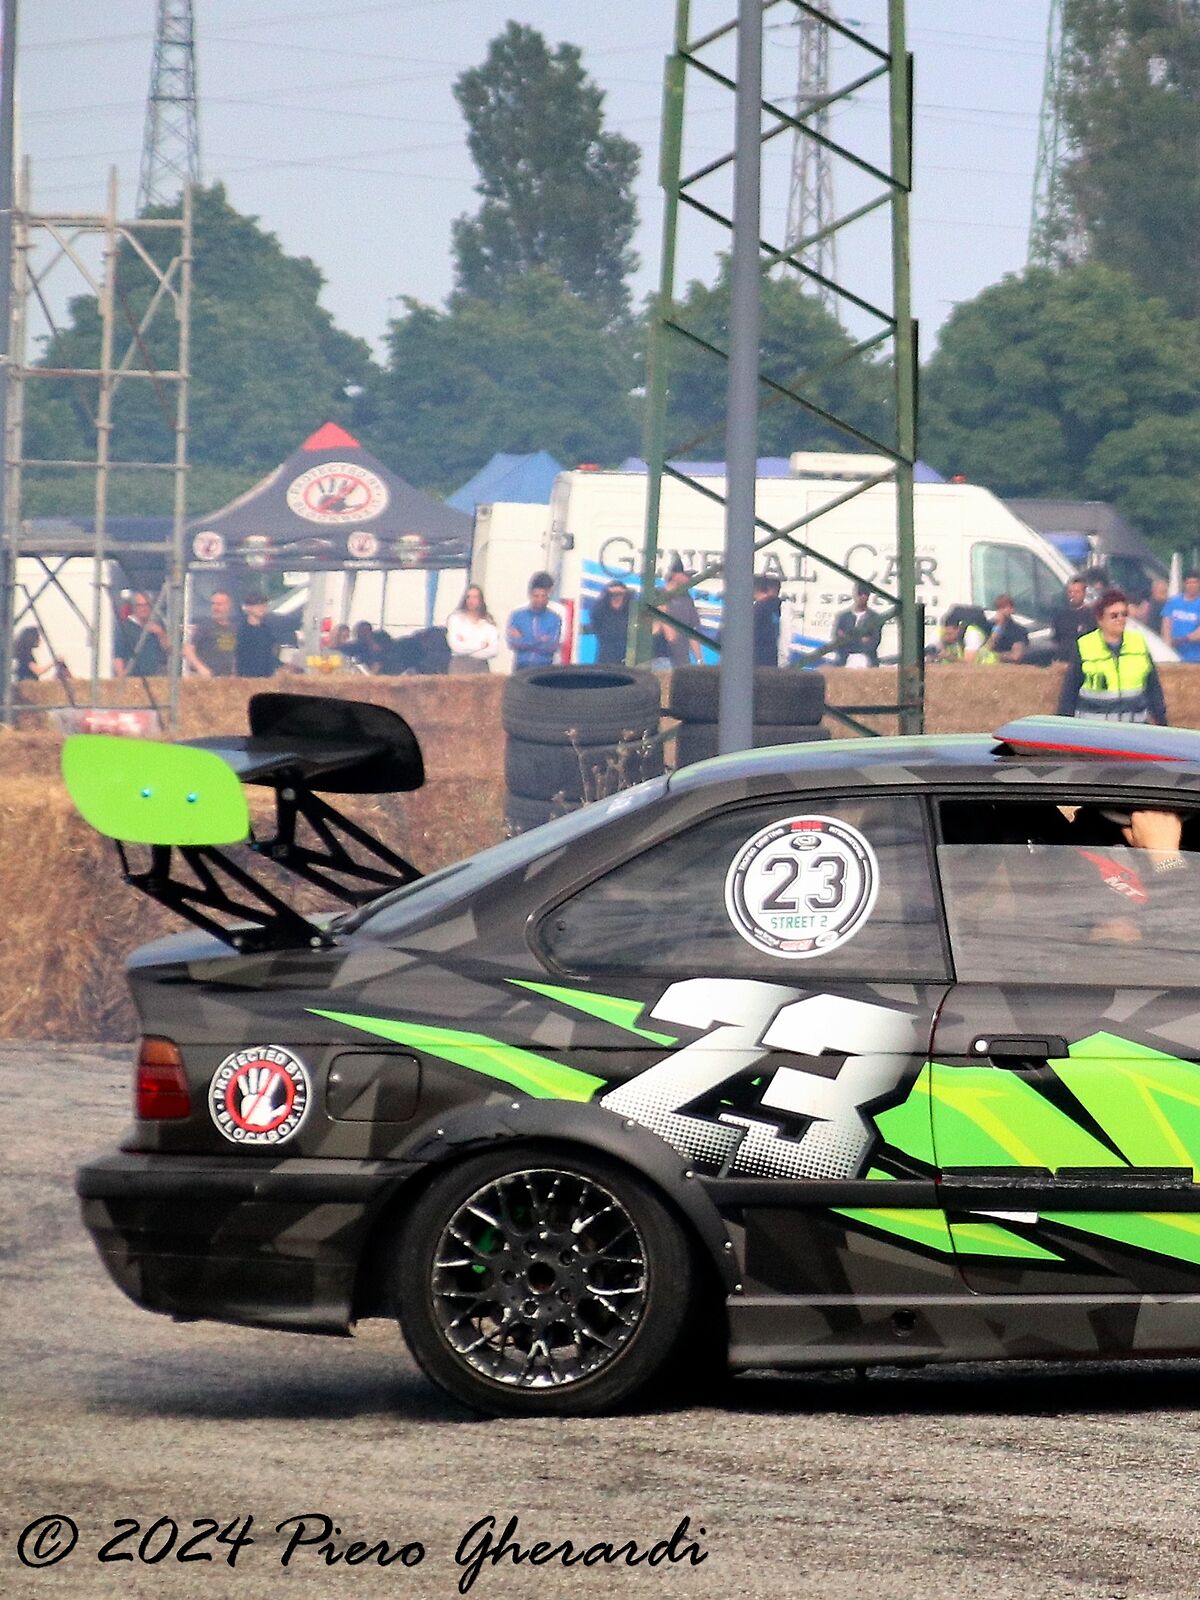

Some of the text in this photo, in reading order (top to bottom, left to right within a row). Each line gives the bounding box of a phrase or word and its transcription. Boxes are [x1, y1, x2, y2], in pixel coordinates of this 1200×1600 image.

[759, 854, 849, 912] 23
[770, 916, 828, 929] STREET 2
[213, 1049, 304, 1100] PROTECTED BY
[600, 977, 919, 1181] 23
[217, 1095, 306, 1142] BLOCKBOX.IT
